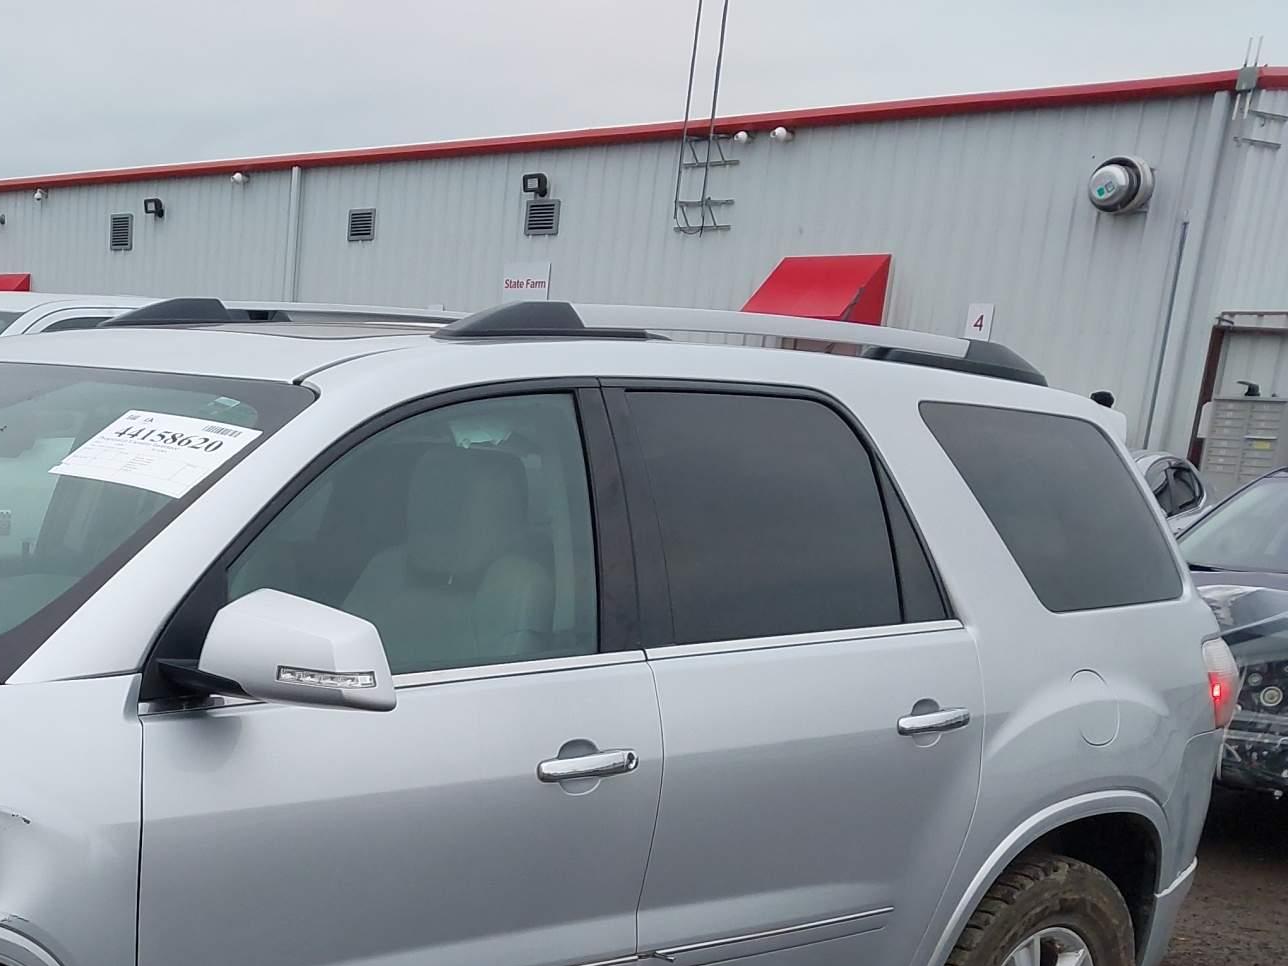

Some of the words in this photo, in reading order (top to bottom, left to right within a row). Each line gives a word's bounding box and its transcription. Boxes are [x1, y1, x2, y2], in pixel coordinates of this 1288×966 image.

[504, 279, 524, 289] State
[525, 278, 546, 289] Farm
[973, 314, 984, 332] 4
[114, 425, 224, 453] 44158620
